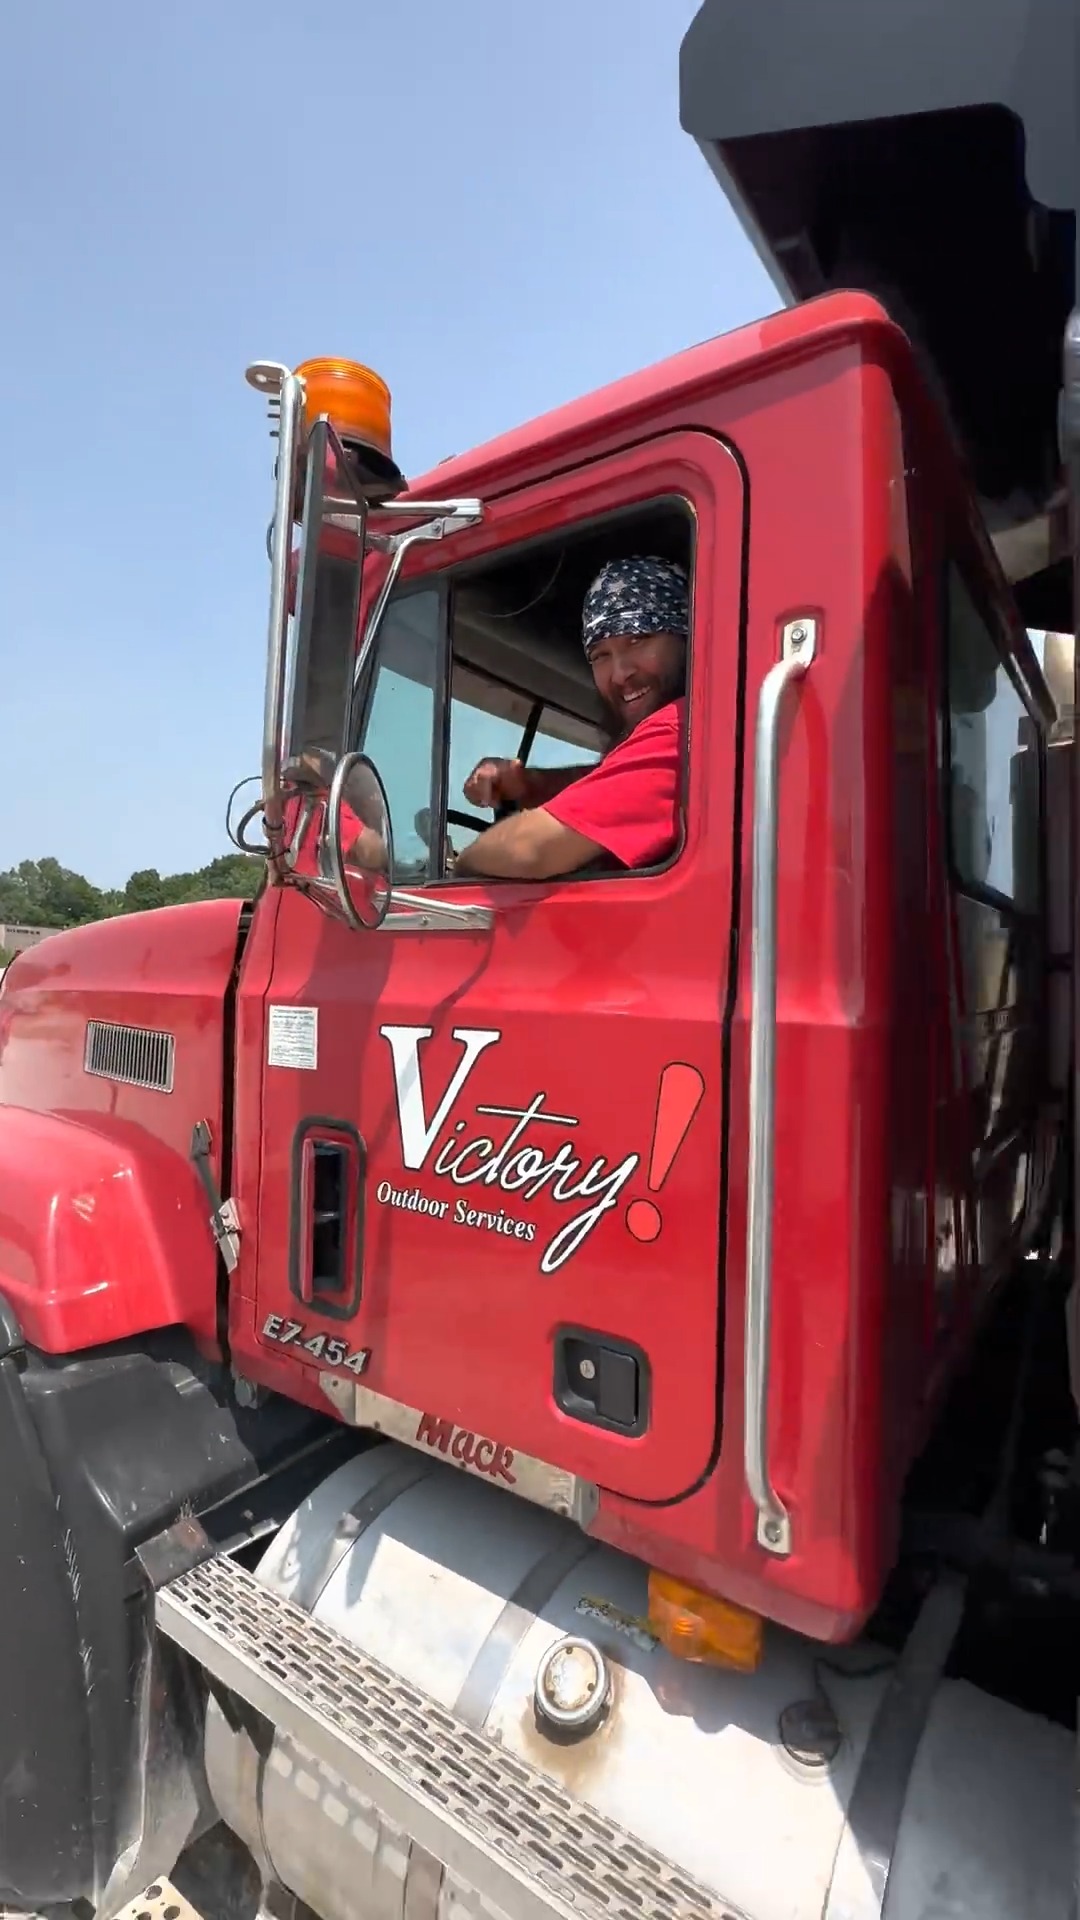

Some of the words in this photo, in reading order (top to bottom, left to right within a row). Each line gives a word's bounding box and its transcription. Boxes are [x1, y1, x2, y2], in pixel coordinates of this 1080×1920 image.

[379, 1025, 706, 1274] Victory!
[376, 1181, 449, 1219] Outdoor
[453, 1199, 537, 1242] Services
[262, 1313, 371, 1376] E7-454
[415, 1411, 517, 1486] Mack
